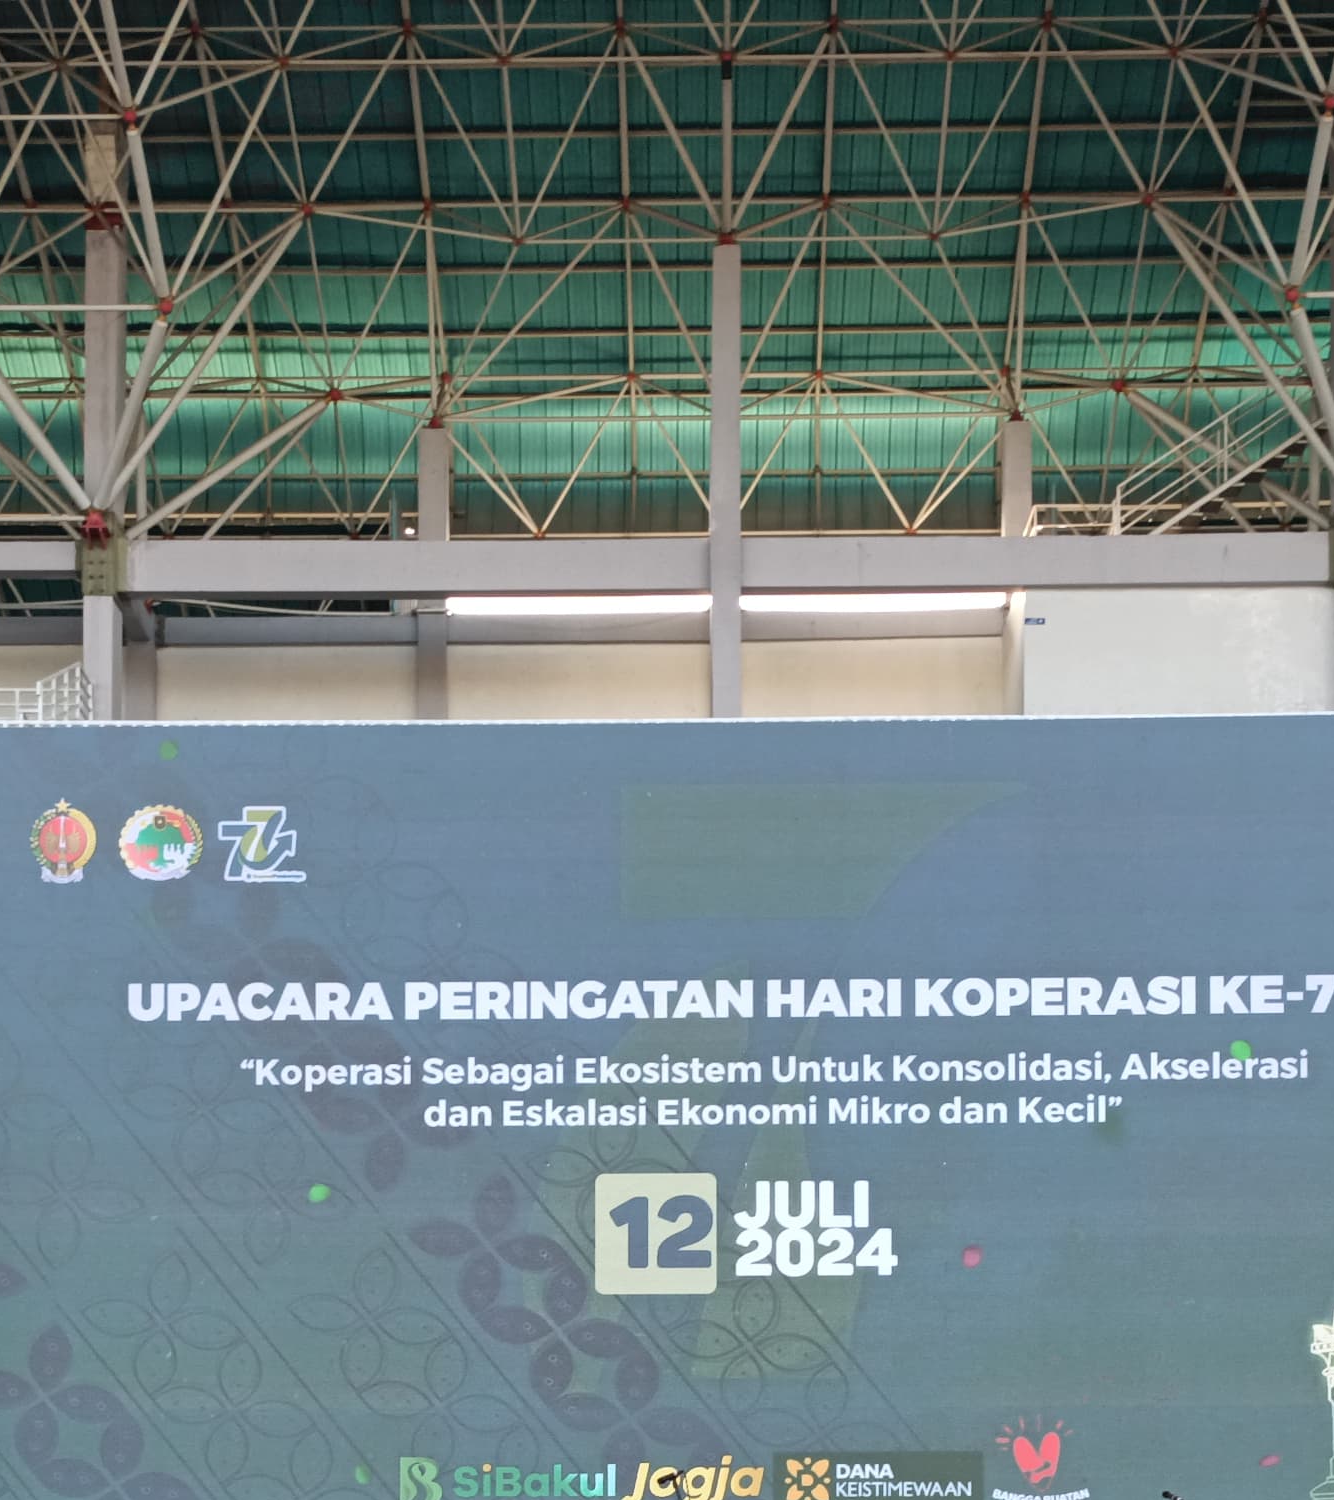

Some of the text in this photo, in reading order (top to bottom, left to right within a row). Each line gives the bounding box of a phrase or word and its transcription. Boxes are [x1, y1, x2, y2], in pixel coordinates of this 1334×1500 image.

[128, 982, 393, 1022] UPACARA
[405, 979, 754, 1020] PERINGATAN
[767, 978, 901, 1018] HARI
[915, 976, 1196, 1017] KOPERASI
[241, 1048, 1309, 1092] “Koperasi Sebagai Ekosistem Untuk Konsolidasi, Akselerasi
[424, 1093, 1123, 1128] dan Eskalasi Ekonomi Mikro dan Kecil”
[733, 1180, 869, 1229] JULI
[609, 1194, 713, 1268] 12
[735, 1228, 898, 1277] 2024
[452, 1463, 616, 1498] SiBakul
[835, 1463, 894, 1480] DANA
[835, 1480, 972, 1497] KEISTIMEWAAN
